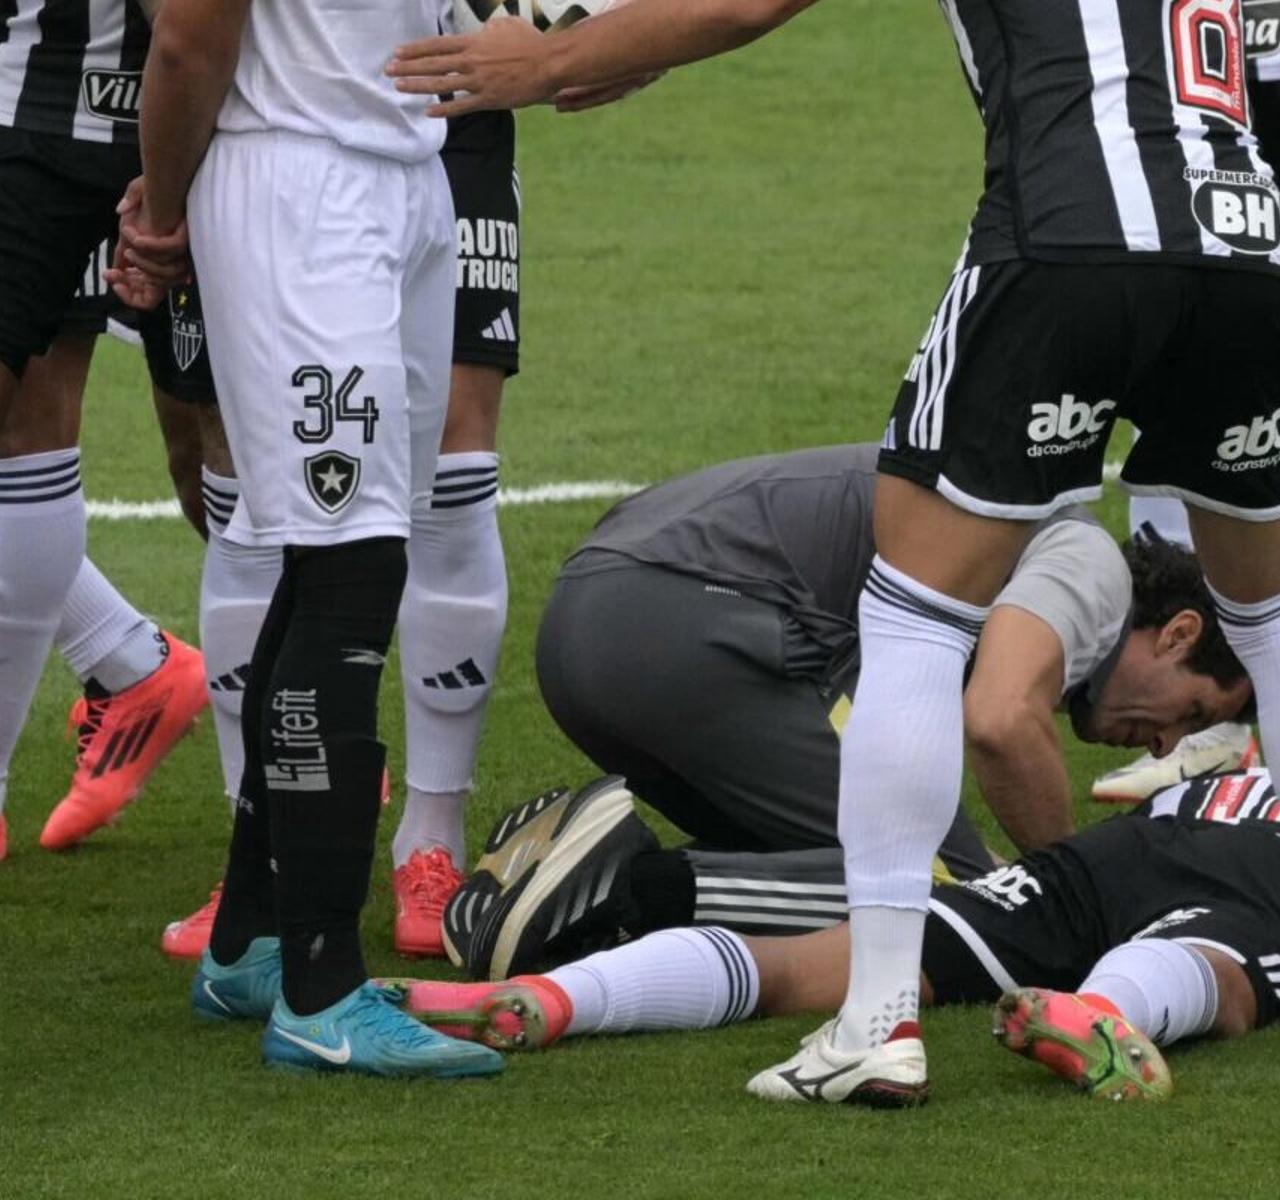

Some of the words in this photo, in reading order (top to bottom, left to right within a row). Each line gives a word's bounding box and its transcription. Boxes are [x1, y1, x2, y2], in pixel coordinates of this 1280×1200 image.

[456, 218, 518, 259] AUTO
[1211, 189, 1276, 243] BH
[291, 364, 380, 445] 34
[1027, 393, 1117, 442] abc
[270, 687, 327, 765] Lifefit
